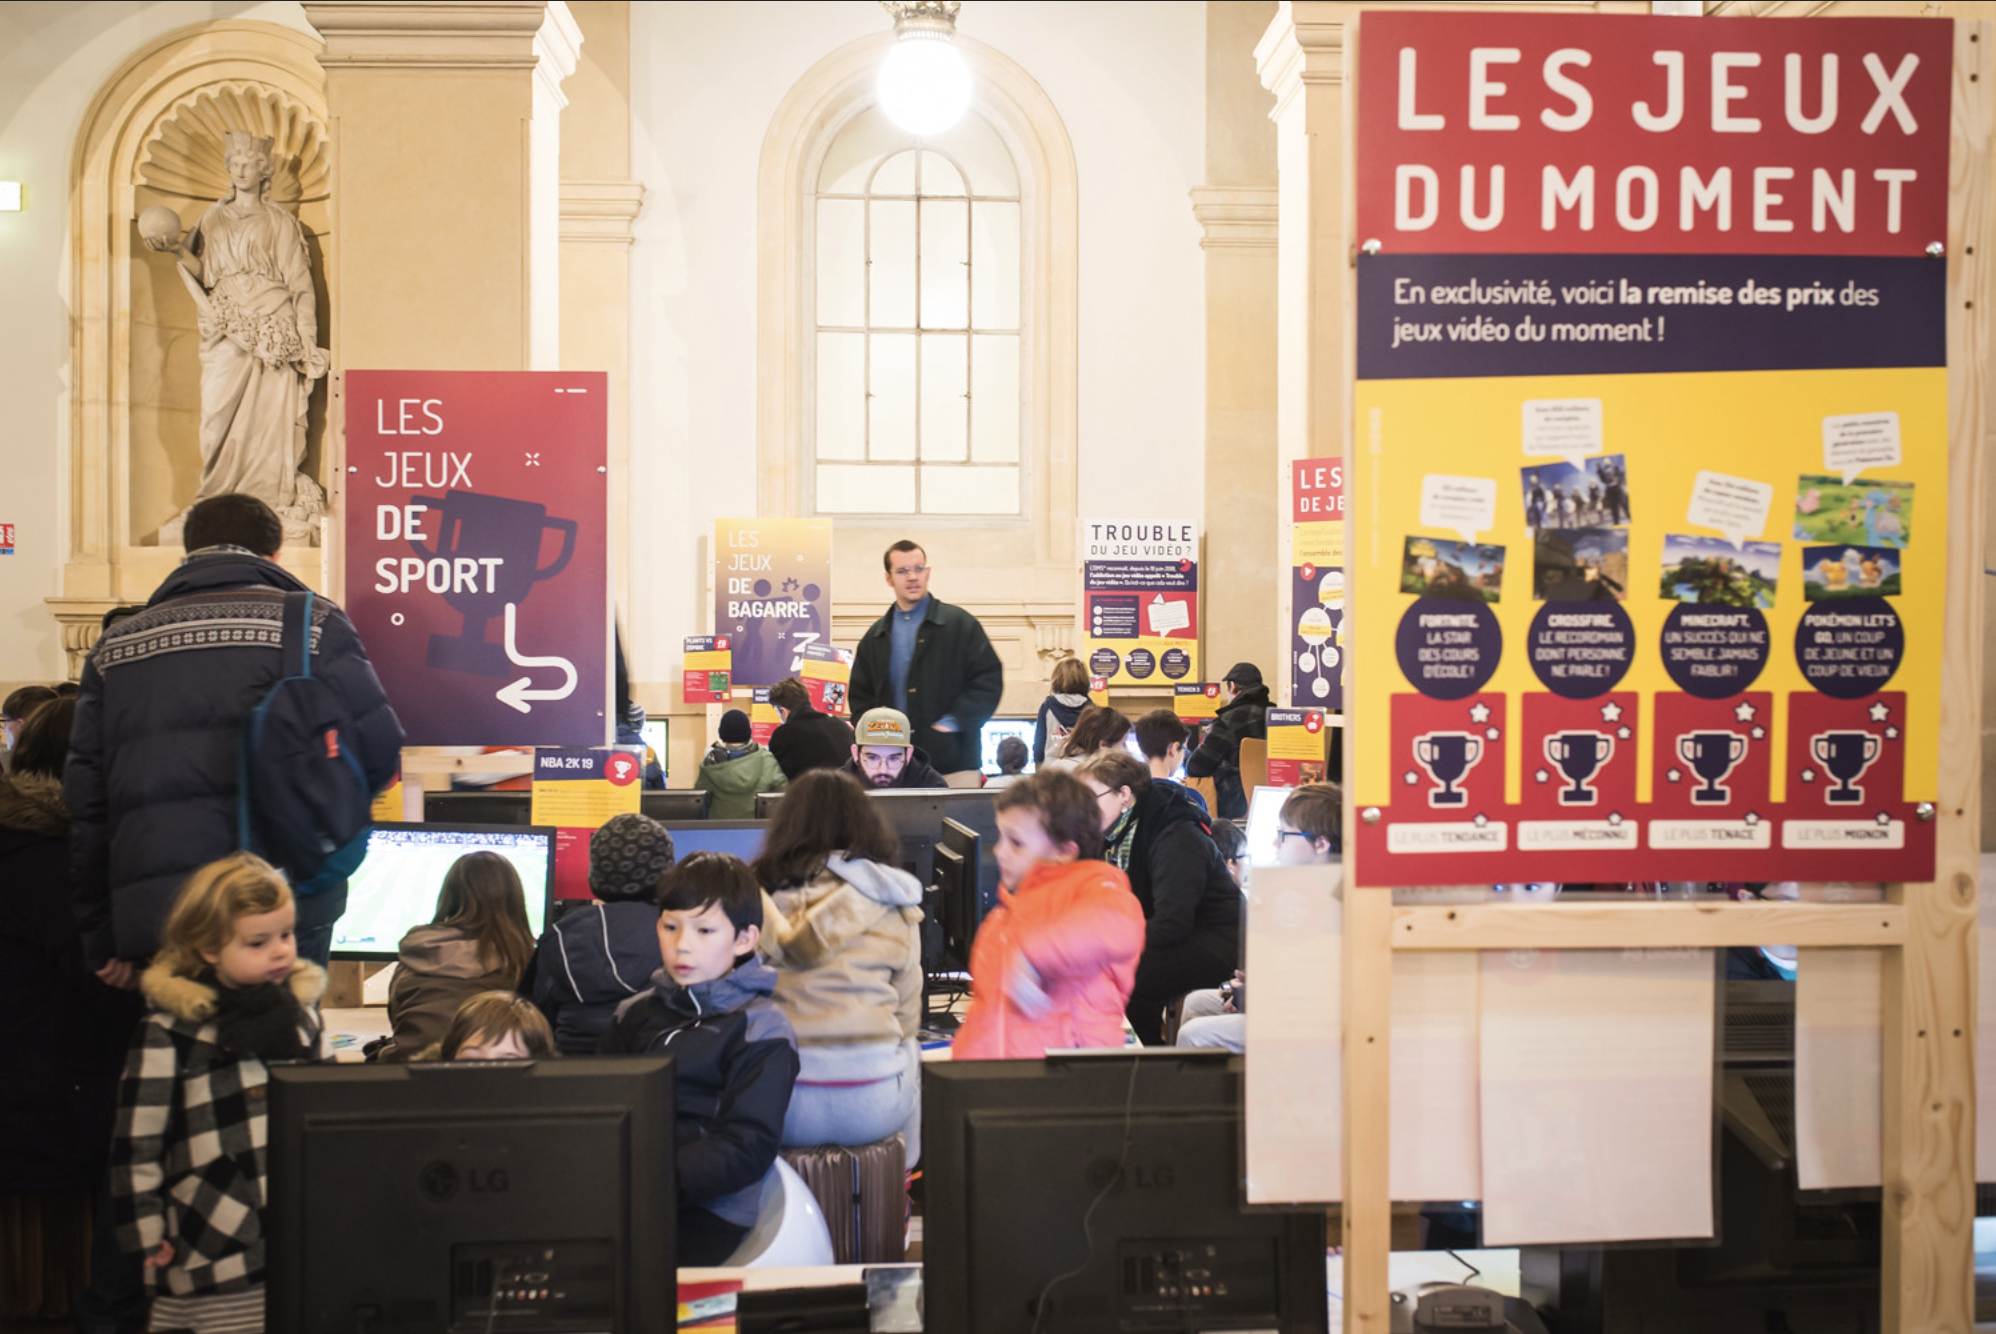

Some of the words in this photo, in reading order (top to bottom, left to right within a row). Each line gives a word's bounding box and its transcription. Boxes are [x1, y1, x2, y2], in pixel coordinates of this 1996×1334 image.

[1398, 47, 1594, 132] LES
[1632, 51, 1920, 135] JEUX
[1394, 164, 1505, 231] DU
[1541, 165, 1917, 233] MOMENT
[1394, 278, 1425, 304] En
[1430, 278, 1557, 307] exclusivité,
[1562, 280, 1614, 304] voici
[1619, 279, 1642, 304] la
[1647, 280, 1734, 305] remise
[1738, 279, 1782, 305] des
[1787, 281, 1835, 311] prix
[1840, 281, 1880, 306] des
[1391, 316, 1443, 348] jeux
[1447, 315, 1510, 341] vidéo
[1515, 315, 1547, 341] du
[1552, 317, 1652, 342] moment
[1658, 317, 1665, 342] !
[378, 399, 443, 434] LES
[376, 452, 472, 487] JEUX
[1301, 466, 1342, 489] LES
[1301, 497, 1321, 512] DE
[377, 505, 427, 540] DE
[729, 530, 759, 547] LES
[1091, 525, 1191, 541] TROUBLE
[1091, 545, 1107, 555] DU
[1113, 545, 1138, 555] JEU
[1144, 543, 1182, 556] VIDÉO
[1186, 546, 1191, 556] ?
[728, 554, 771, 571] JEUX
[375, 558, 503, 593] SPORT
[729, 578, 752, 594] DE
[729, 601, 810, 618] BAGARRE
[1271, 712, 1301, 721] BROTHERS
[541, 756, 564, 768] NBA
[565, 757, 580, 768] 2K
[582, 758, 593, 769] 19
[1844, 829, 1890, 840] MIGNON
